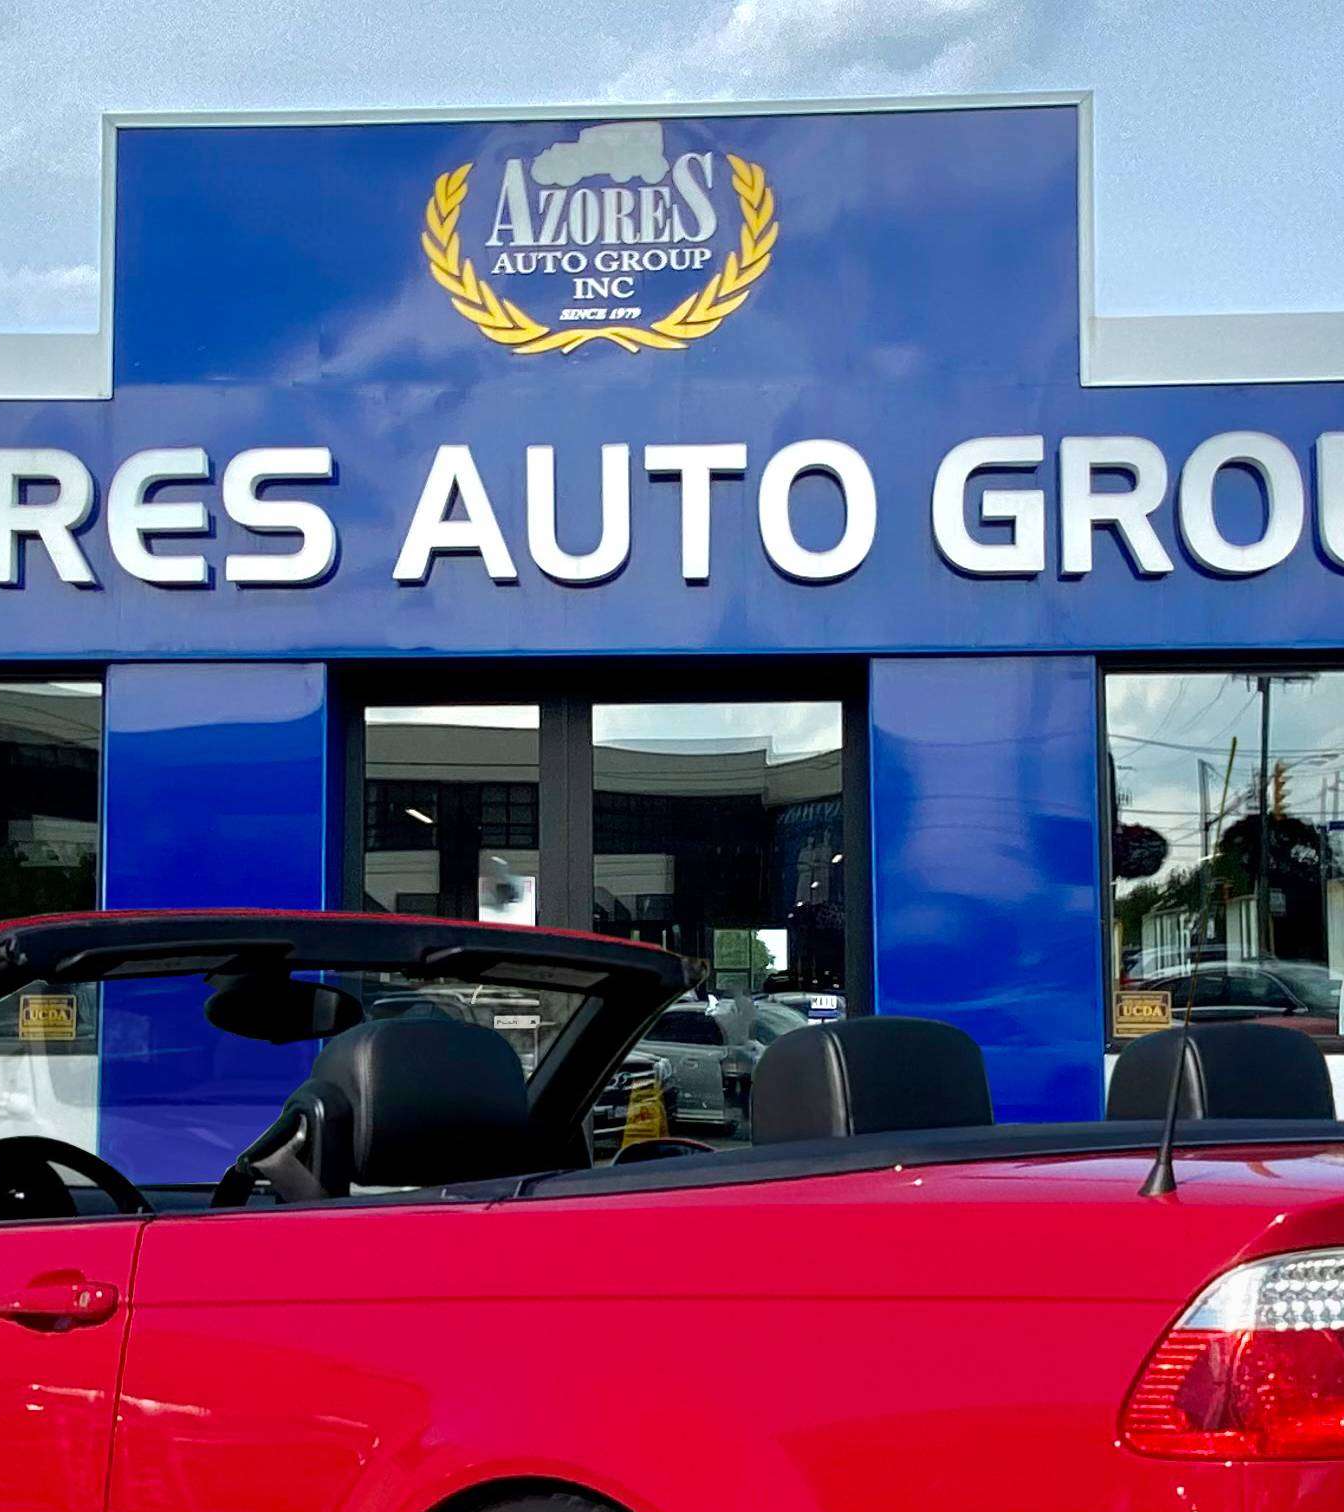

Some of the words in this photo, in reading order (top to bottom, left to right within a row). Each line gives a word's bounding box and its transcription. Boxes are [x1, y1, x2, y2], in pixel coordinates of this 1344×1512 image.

[485, 152, 718, 247] AZORES
[490, 250, 588, 275] AUTO
[594, 248, 712, 273] GROUP
[573, 277, 634, 299] INC
[559, 308, 606, 320] SINCE
[609, 307, 641, 319] 1979
[392, 439, 877, 586] AUTO
[30, 1009, 67, 1020] UCDA
[1123, 1005, 1162, 1016] UCDA
